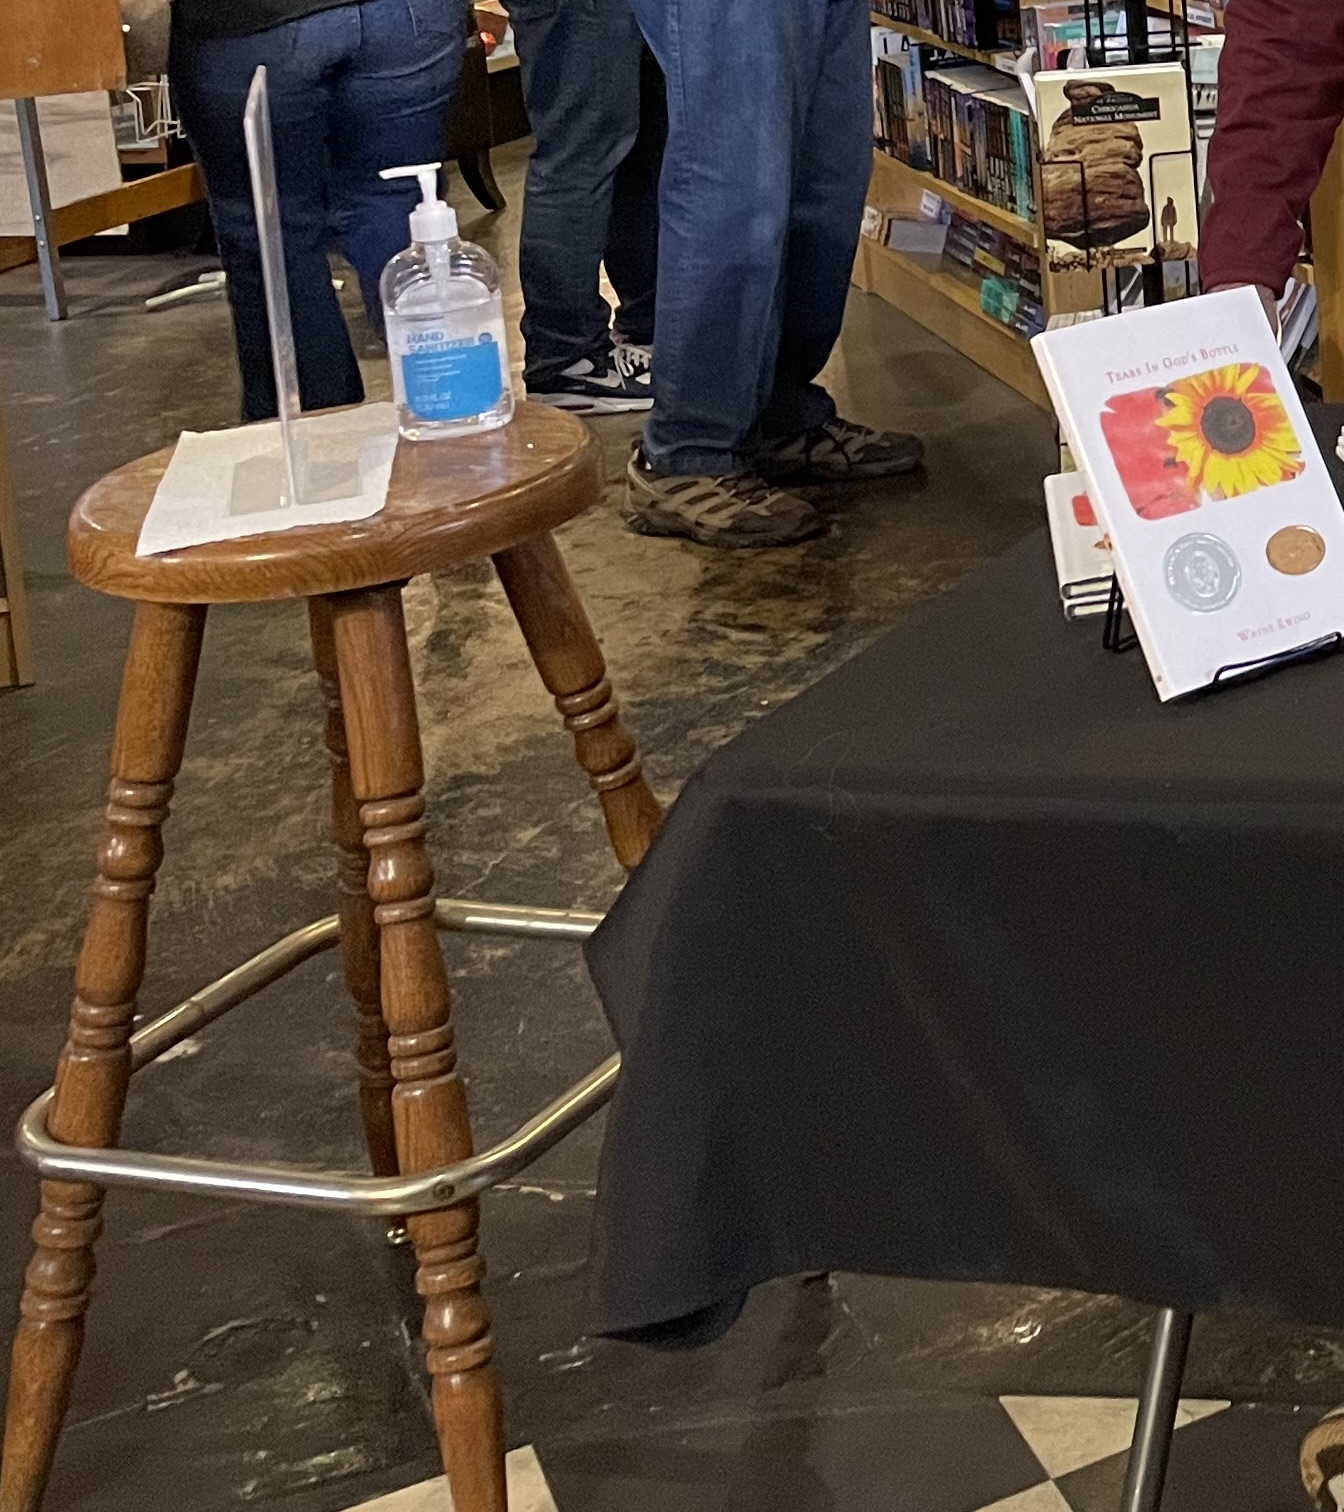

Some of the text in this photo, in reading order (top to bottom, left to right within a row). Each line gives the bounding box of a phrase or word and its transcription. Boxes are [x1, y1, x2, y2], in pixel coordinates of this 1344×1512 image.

[1074, 114, 1112, 124] NATIONAL
[407, 332, 444, 344] HAND
[1105, 367, 1142, 384] TEARS
[1145, 361, 1159, 374] IN
